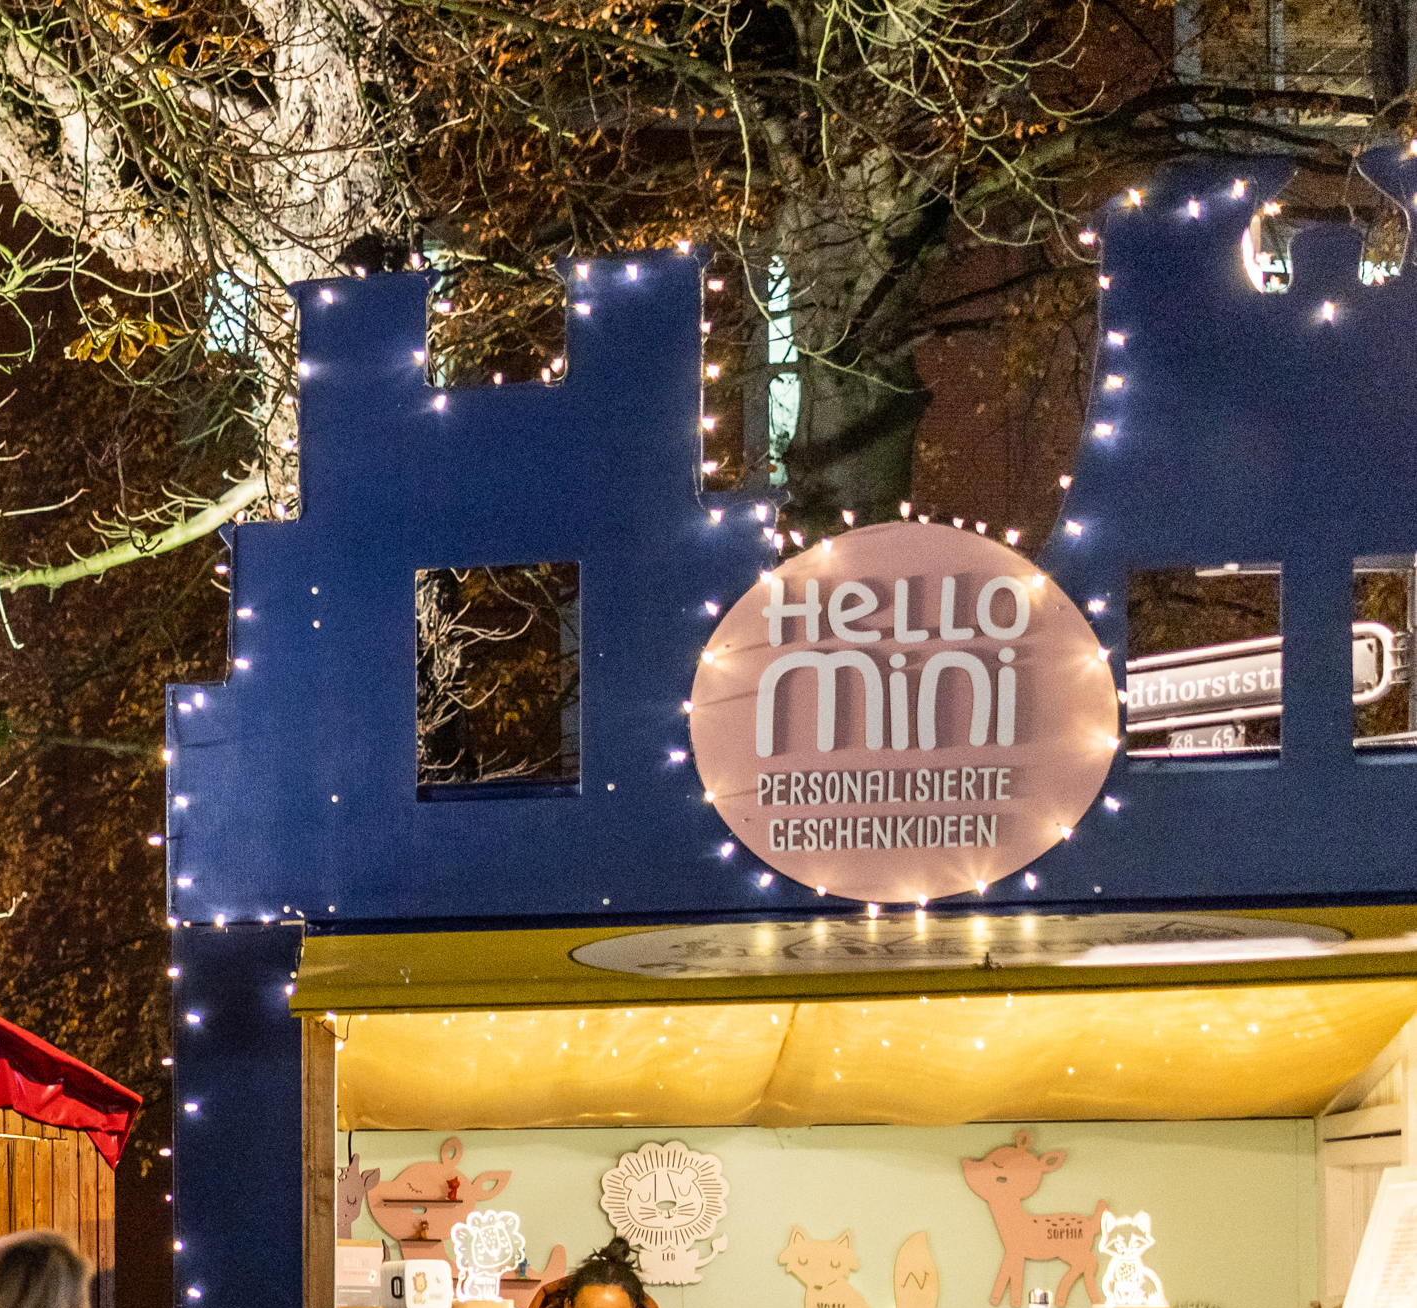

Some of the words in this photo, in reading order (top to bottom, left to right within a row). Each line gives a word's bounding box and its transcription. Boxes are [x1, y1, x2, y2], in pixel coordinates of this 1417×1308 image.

[758, 767, 1011, 806] PERSONALISIERTE
[769, 814, 997, 851] GESCHENKIDEEN
[1047, 1228, 1083, 1239] SOPHIA
[662, 1252, 676, 1261] LEO
